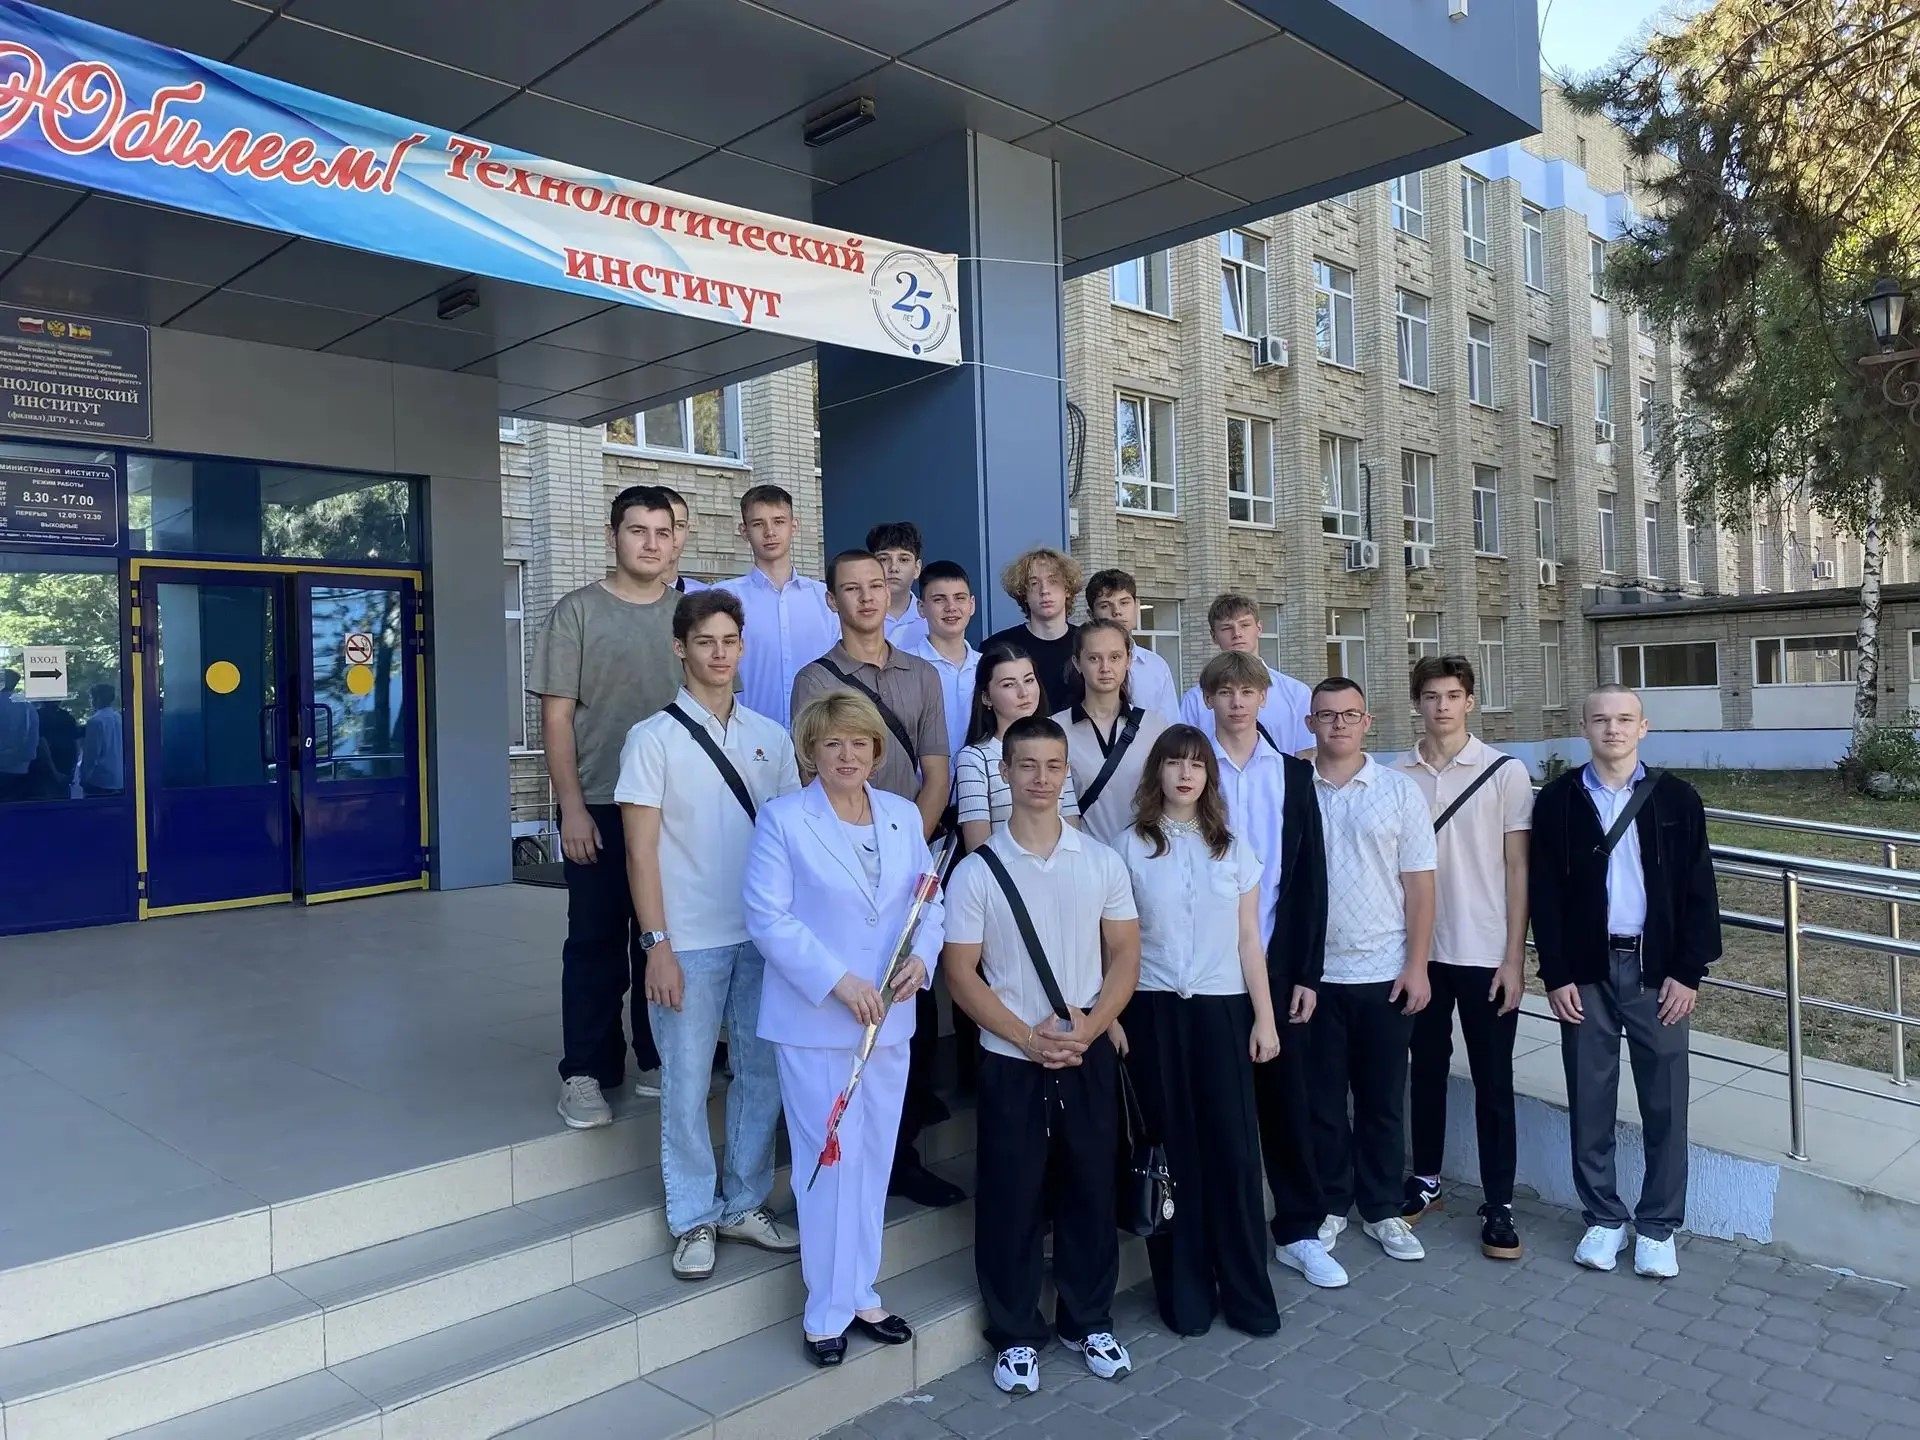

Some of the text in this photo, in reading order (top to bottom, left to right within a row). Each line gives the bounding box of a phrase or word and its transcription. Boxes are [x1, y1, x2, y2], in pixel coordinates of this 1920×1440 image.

[444, 135, 867, 275] Технологический
[563, 247, 783, 324] институт
[891, 271, 933, 331] 25
[13, 394, 101, 415] ИНСТИТУТ
[7, 411, 46, 422] (филиал)
[46, 415, 68, 424] ДГТУ
[64, 469, 110, 479] ИНСТИТУТА
[32, 479, 56, 487] РЕЖИМ
[23, 491, 49, 503] 8.30
[61, 494, 94, 506] 17.00
[15, 510, 48, 518] ПЕРЕРЫВ
[58, 511, 77, 519] 12.00
[40, 521, 79, 530] ВЫХОДНЫЕ
[29, 655, 59, 665] ВХОД
